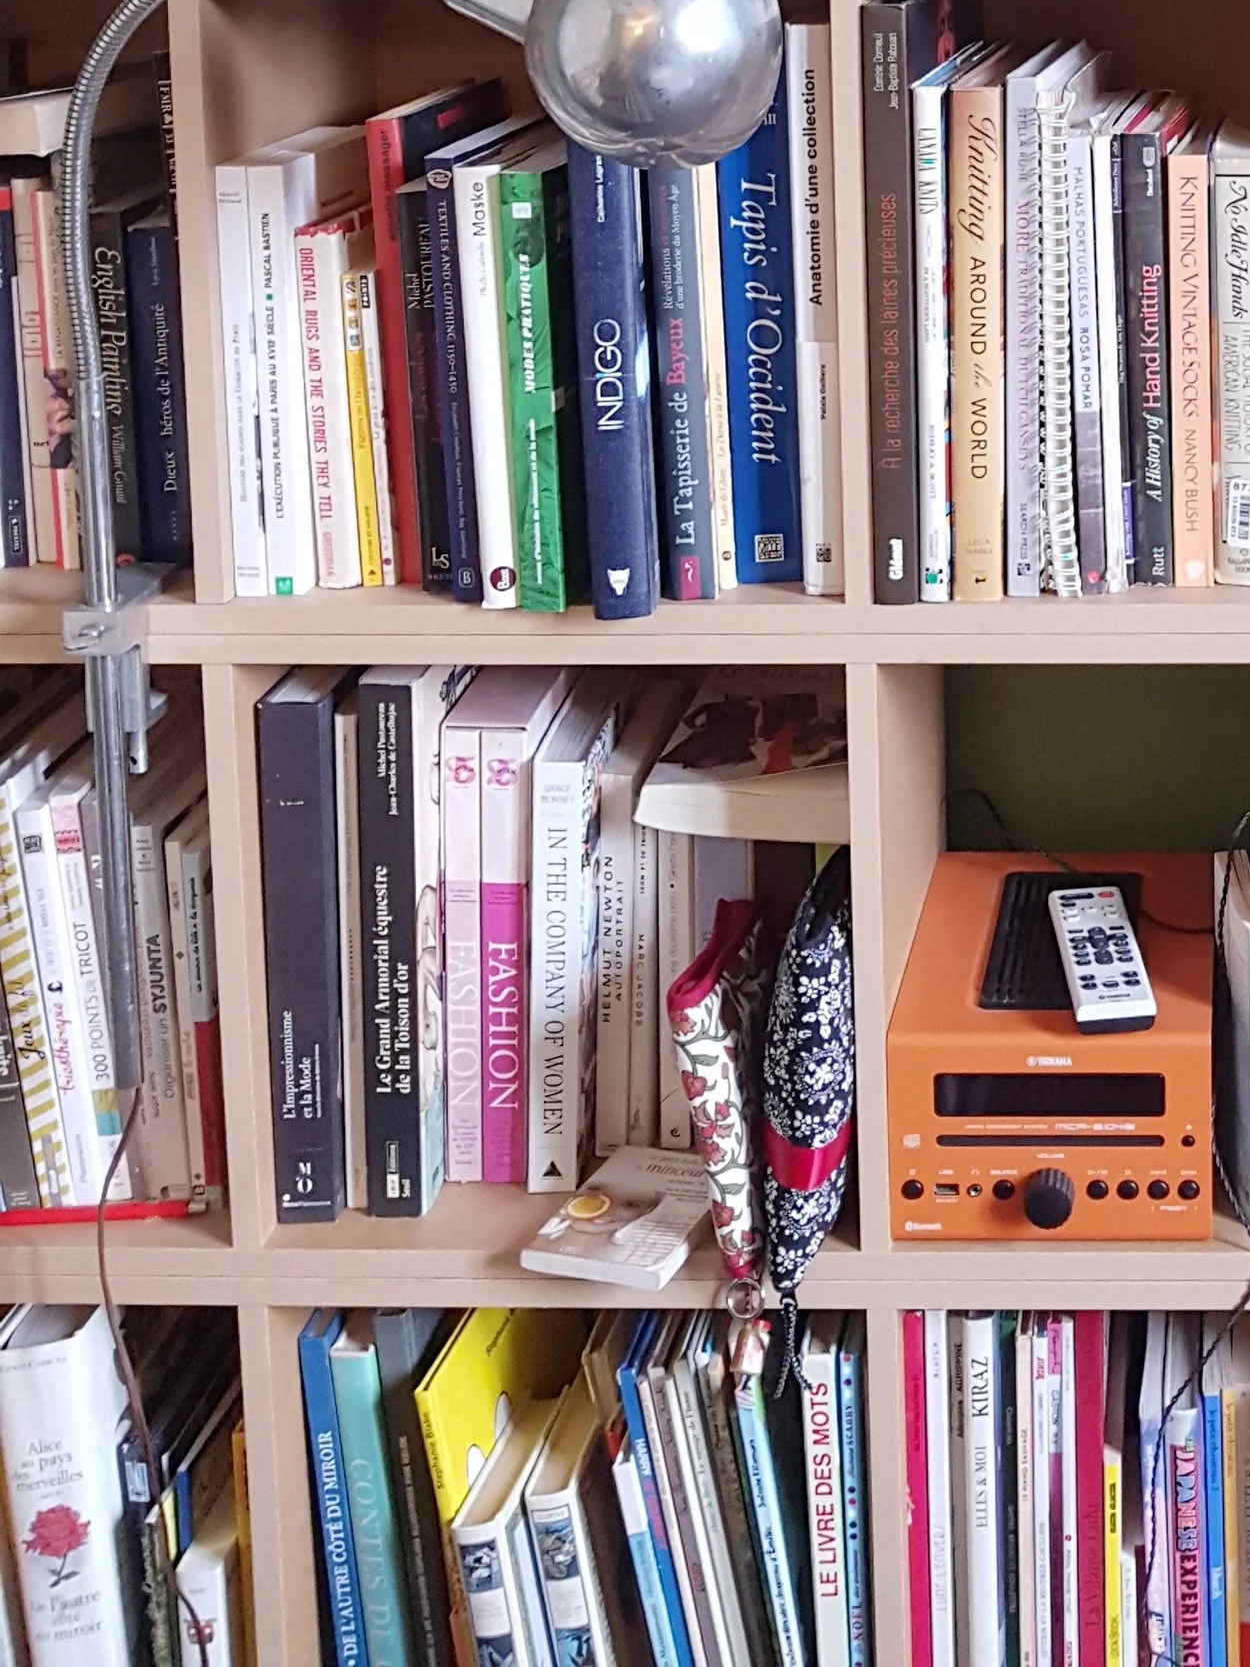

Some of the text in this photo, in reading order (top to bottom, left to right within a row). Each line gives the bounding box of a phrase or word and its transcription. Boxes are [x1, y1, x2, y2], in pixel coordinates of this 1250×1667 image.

[470, 181, 488, 237] Maske
[800, 68, 824, 307] Anatomie d'une collection
[957, 113, 998, 244] Knitting
[89, 247, 127, 415] English Painting
[730, 172, 787, 465] Tapis d'Occident
[878, 192, 900, 469] À la recherche des laines précieuses
[969, 256, 988, 356] AROUND
[298, 247, 334, 521] ORIENTAL RUGS AND THE STORIES THEY TELL
[593, 318, 625, 430] INDIGO
[1138, 264, 1164, 502] A History of Hand Knitting
[665, 317, 699, 545] La Tapisserie de Bayeux
[970, 397, 989, 480] WORLD
[1183, 428, 1199, 483] NANCY
[1151, 546, 1166, 577] Rutt
[1184, 488, 1200, 532] BUSH
[145, 934, 168, 1014] SYJUNTA
[372, 865, 392, 1094] Le Grand Armorial équestre
[394, 998, 410, 1050] Toison
[448, 941, 478, 1105] FASHION
[486, 940, 520, 1109] FASHION
[542, 827, 568, 1136] IN THE COMPANY OF WOMEN
[280, 1010, 297, 1119] L'Impressionnisme
[299, 1057, 314, 1119] et la Mode
[394, 1054, 410, 1069] la
[395, 1073, 411, 1094] de
[1036, 1056, 1072, 1066] YAMAHA
[970, 1356, 990, 1418] KIRAZ
[317, 1431, 359, 1656] DE L'AUTRE CÔTÉ DU MIROIR
[808, 1382, 839, 1597] LE LIVRE DES MOTS
[1173, 1447, 1198, 1553] JAPANESE
